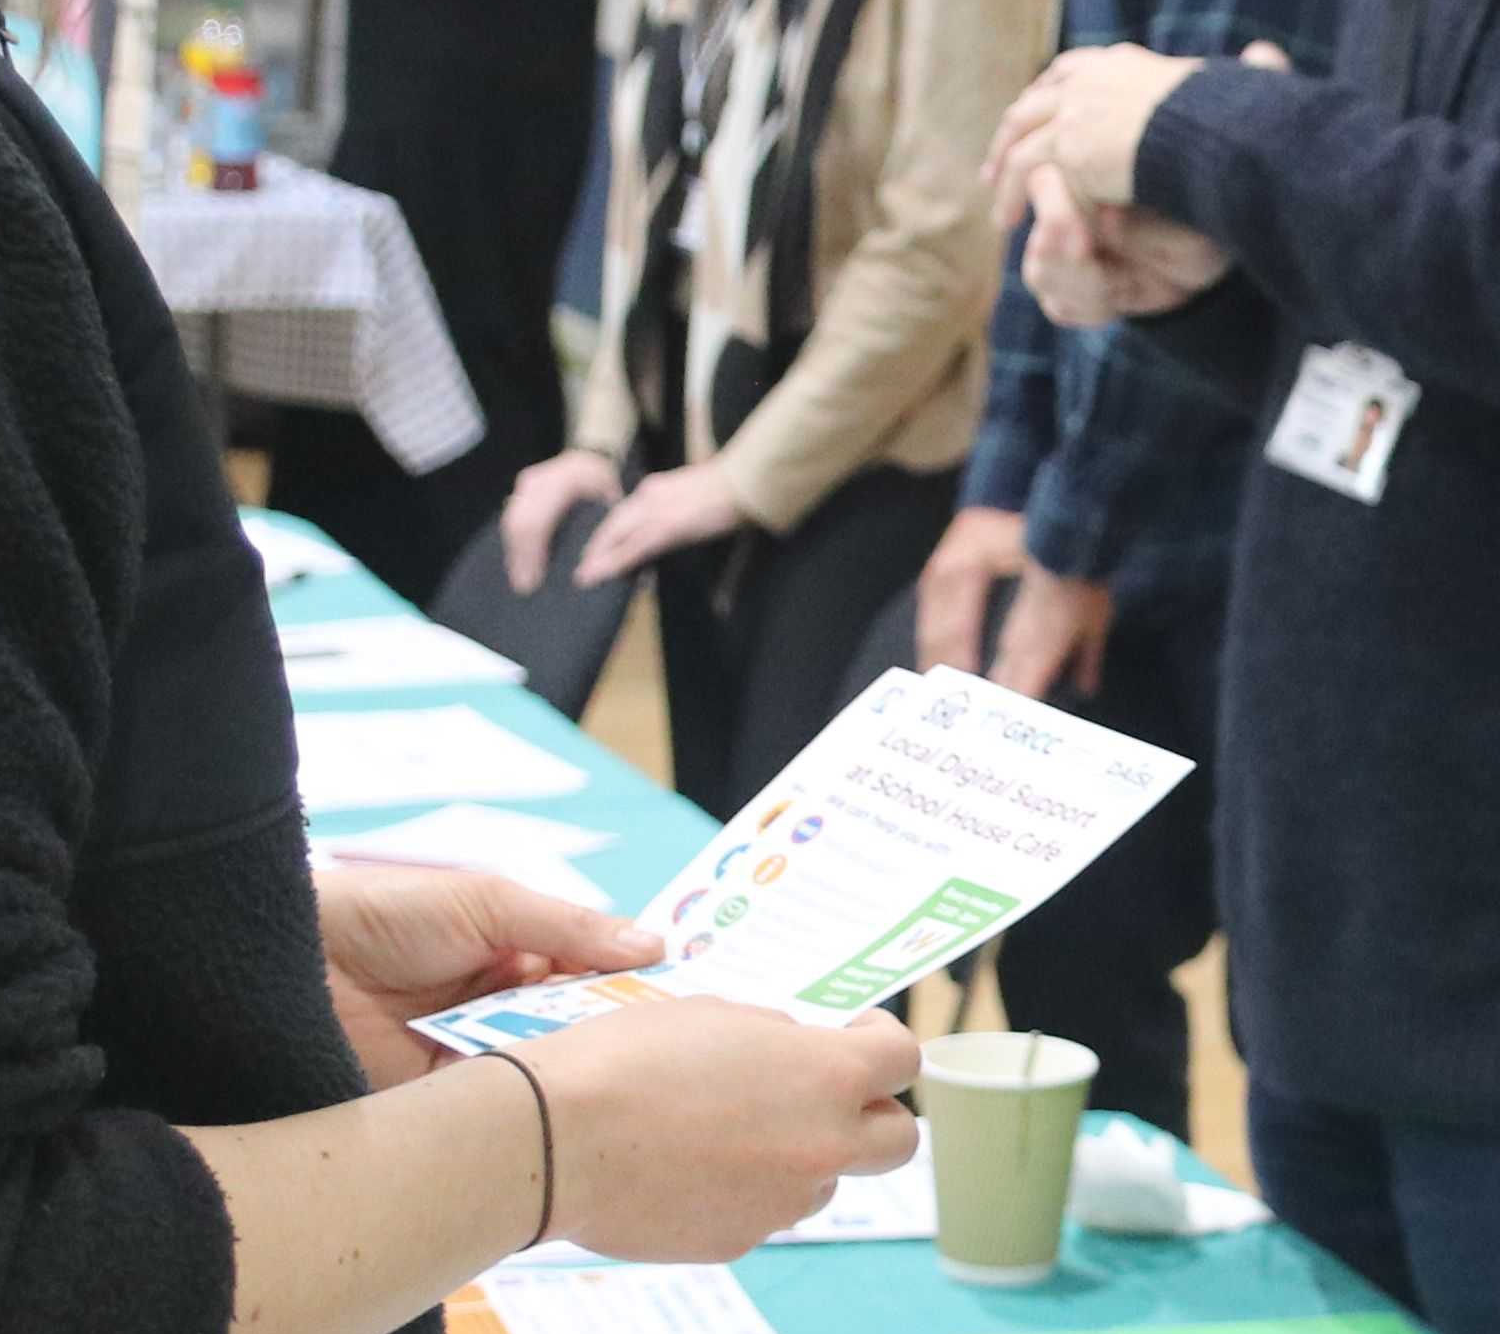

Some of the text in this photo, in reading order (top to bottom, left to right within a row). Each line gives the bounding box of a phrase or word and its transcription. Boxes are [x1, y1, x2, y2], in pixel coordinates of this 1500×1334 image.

[878, 729, 1097, 829] Local Digital Support
[1001, 720, 1064, 756] GRCC
[845, 765, 1062, 863] at School House Café
